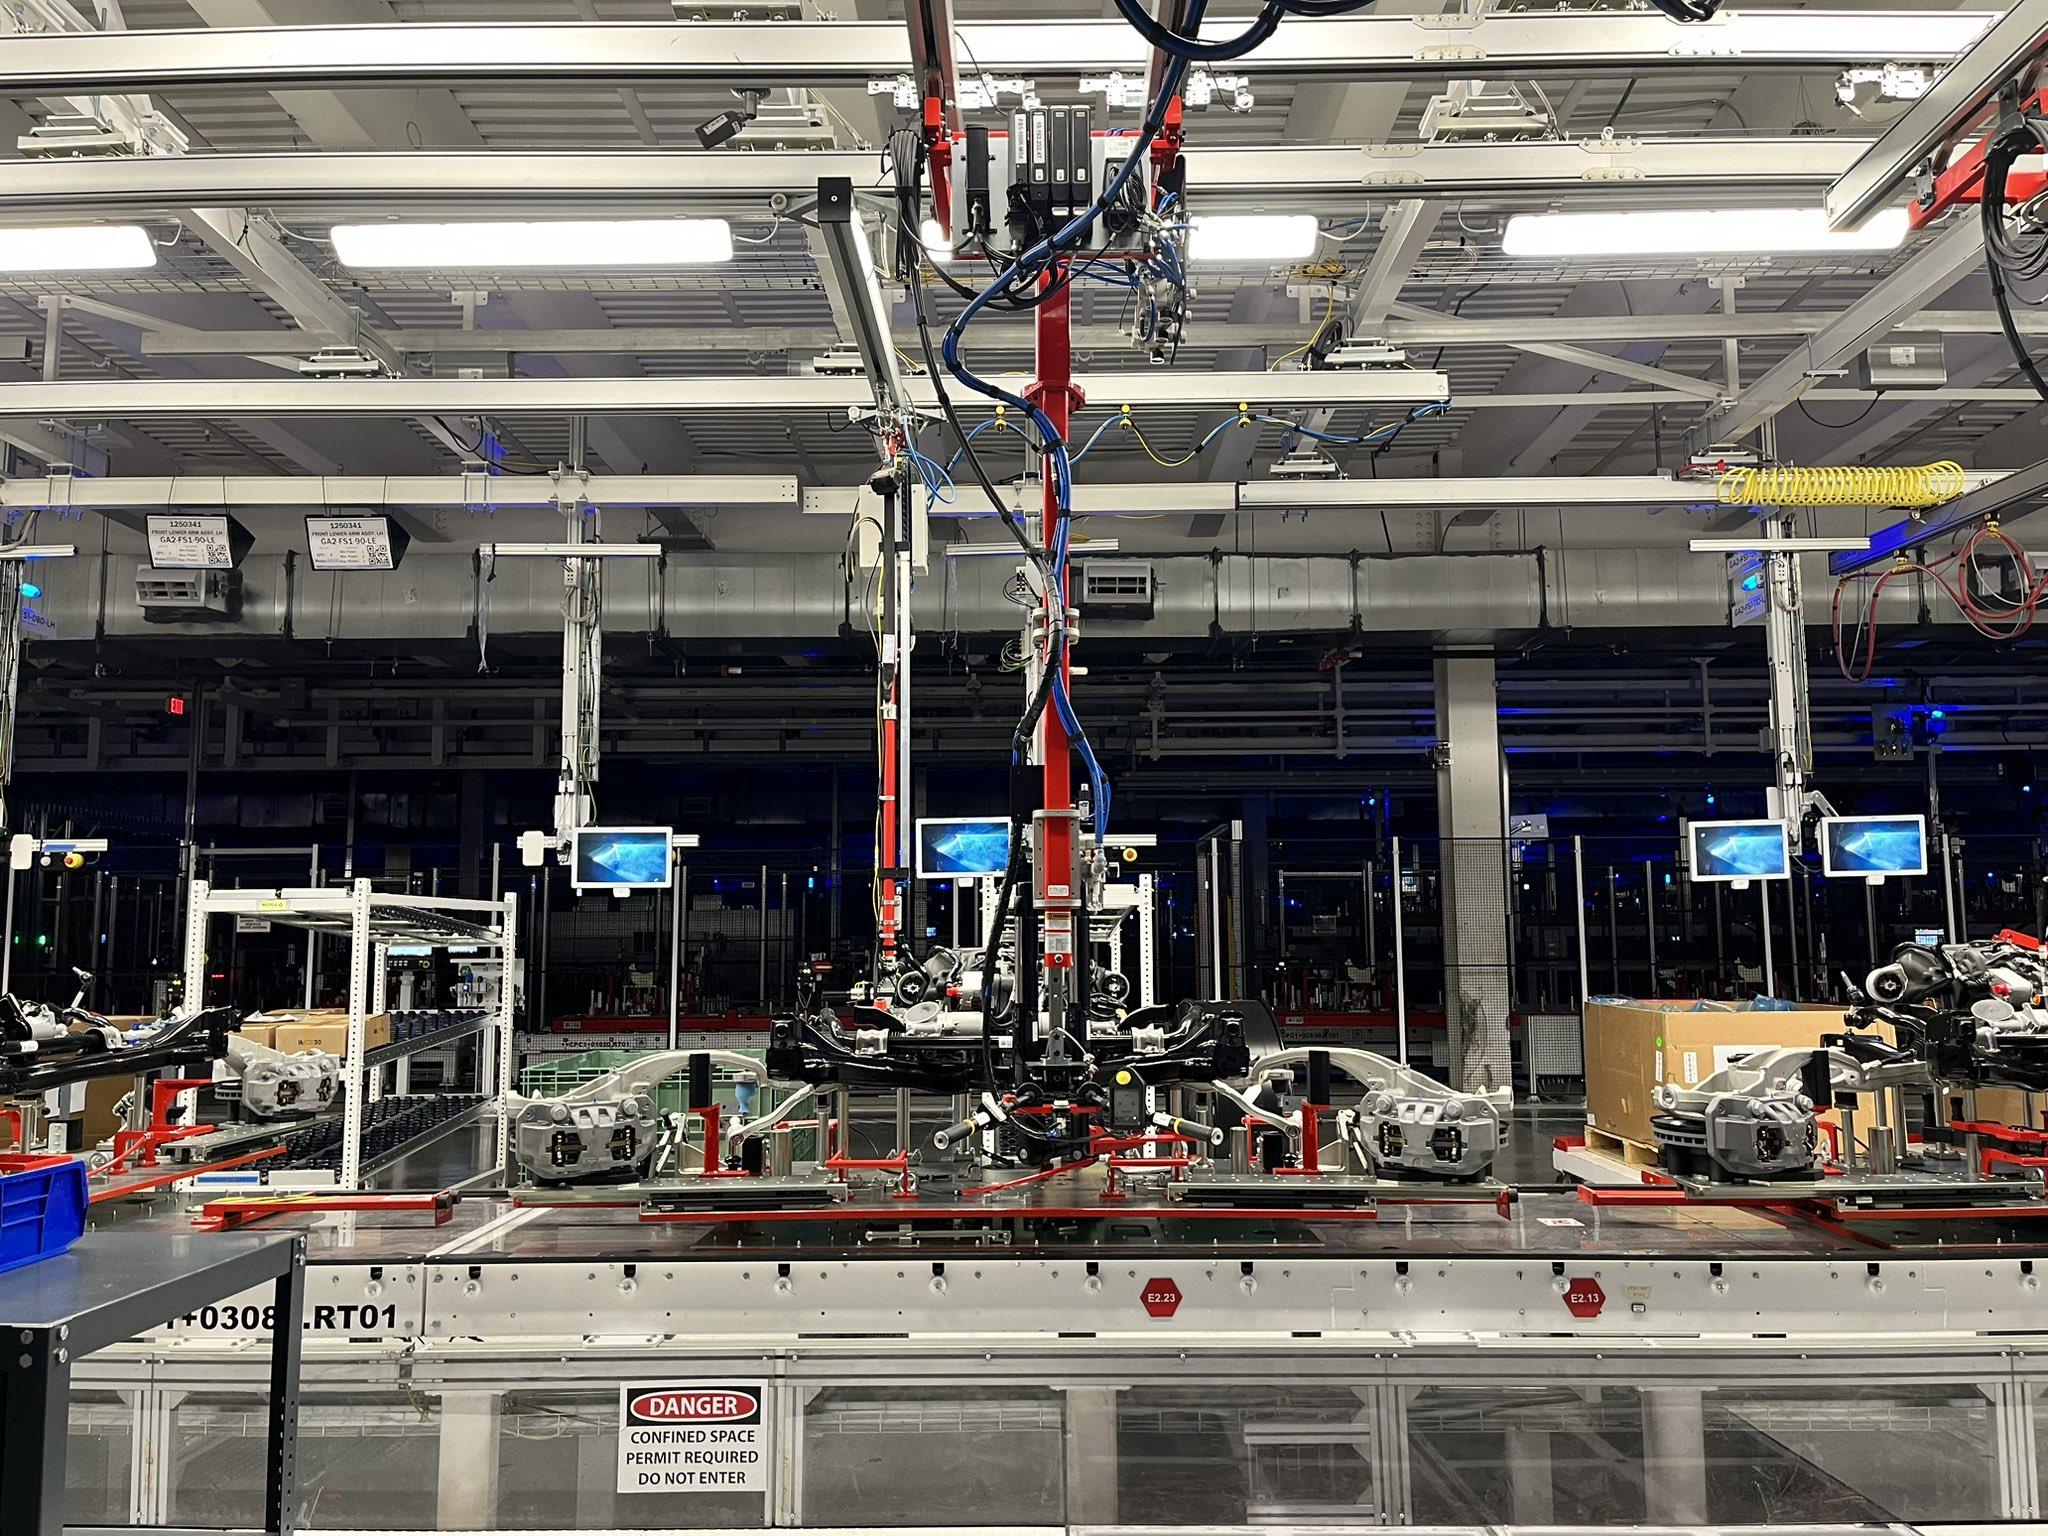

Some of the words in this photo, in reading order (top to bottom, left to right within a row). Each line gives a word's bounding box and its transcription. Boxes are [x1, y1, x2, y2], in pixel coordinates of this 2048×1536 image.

[160, 536, 216, 544] GA2-FS1-90-LE
[1147, 1293, 1176, 1303] E2.23
[1570, 1293, 1599, 1303] E2.13
[649, 1396, 738, 1416] DANGER
[630, 1430, 706, 1444] CONFINED
[710, 1430, 755, 1443] SPACE
[626, 1451, 681, 1465] PERMIT
[684, 1450, 759, 1465] REQUIRED
[638, 1472, 661, 1485] DO
[664, 1472, 695, 1485] NOT
[699, 1471, 746, 1484] ENTER
